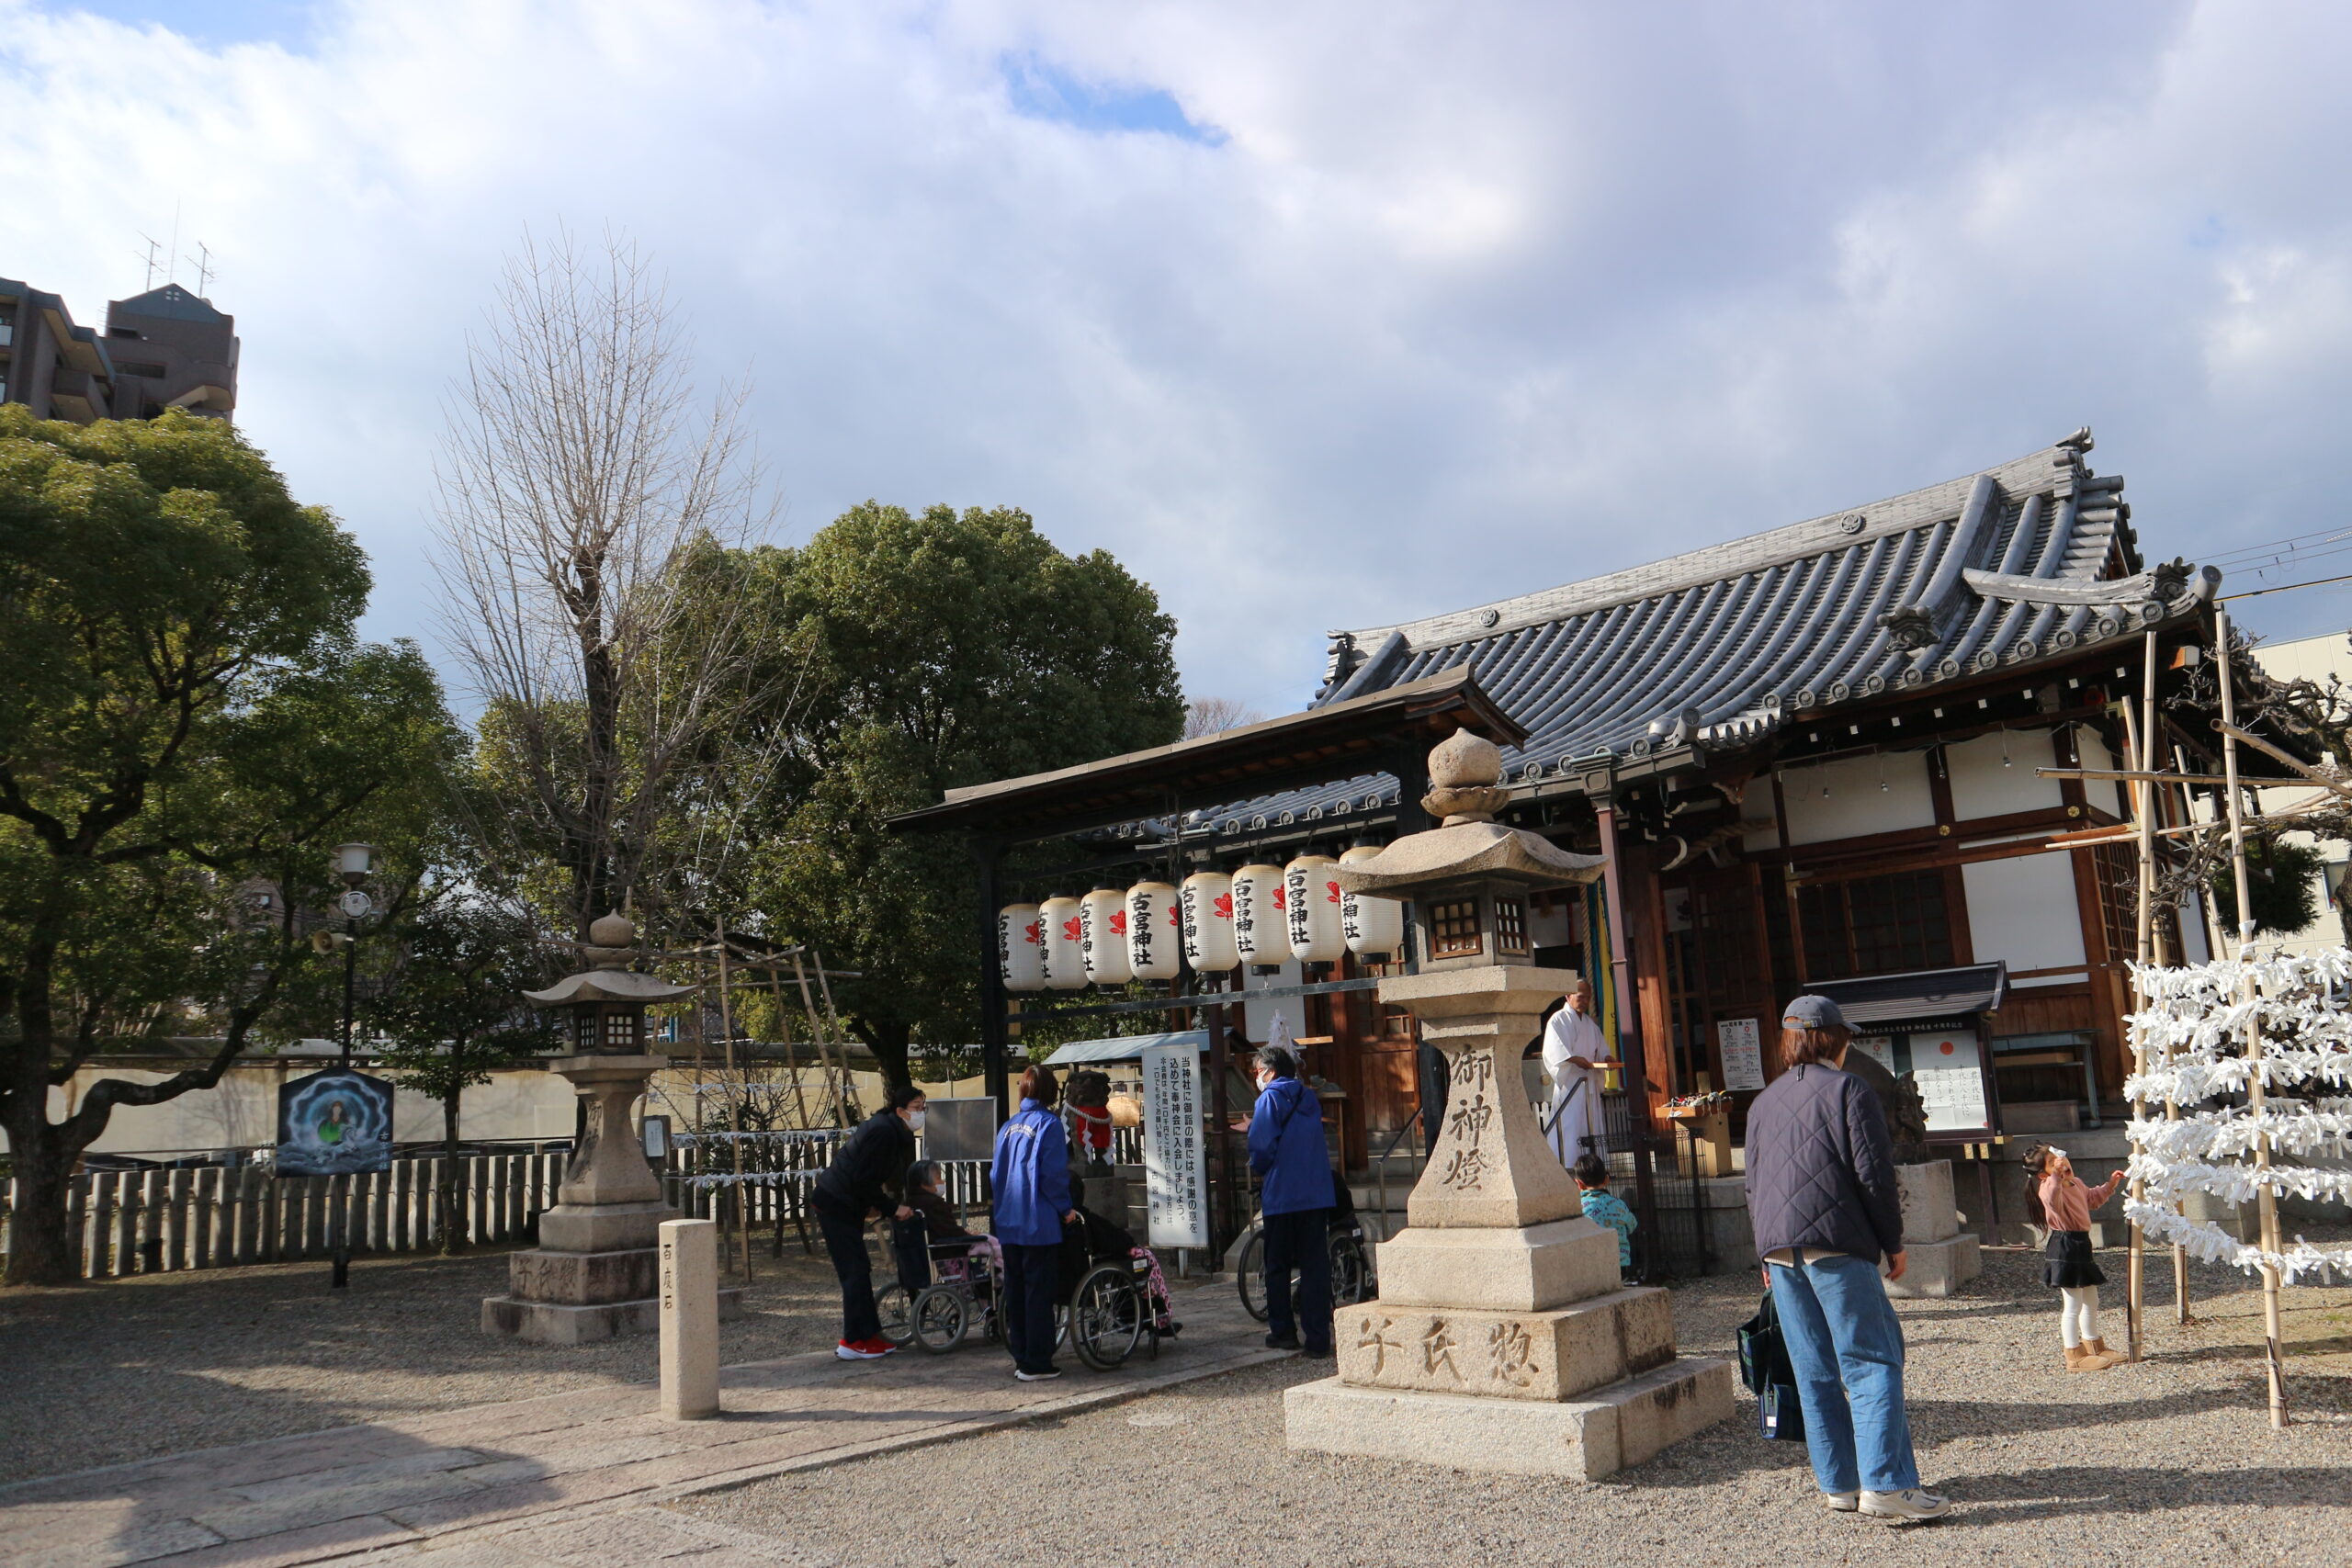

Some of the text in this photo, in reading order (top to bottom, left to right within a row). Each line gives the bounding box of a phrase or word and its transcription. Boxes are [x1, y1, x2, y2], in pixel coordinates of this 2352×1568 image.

[1130, 891, 1153, 967] 古宮神社
[1182, 885, 1200, 957] 古宮神社
[1234, 876, 1255, 954] 古宮神社
[1287, 867, 1311, 946] 古宮神社
[1341, 892, 1361, 940] 神社
[999, 913, 1012, 978] 古宮神社
[1170, 1057, 1185, 1221] 込めて奉神会に入会しましょう。
[1442, 1044, 1492, 1190] 御神燈
[1151, 1171, 1160, 1225] 古宮神社
[662, 1244, 673, 1310] 百度石
